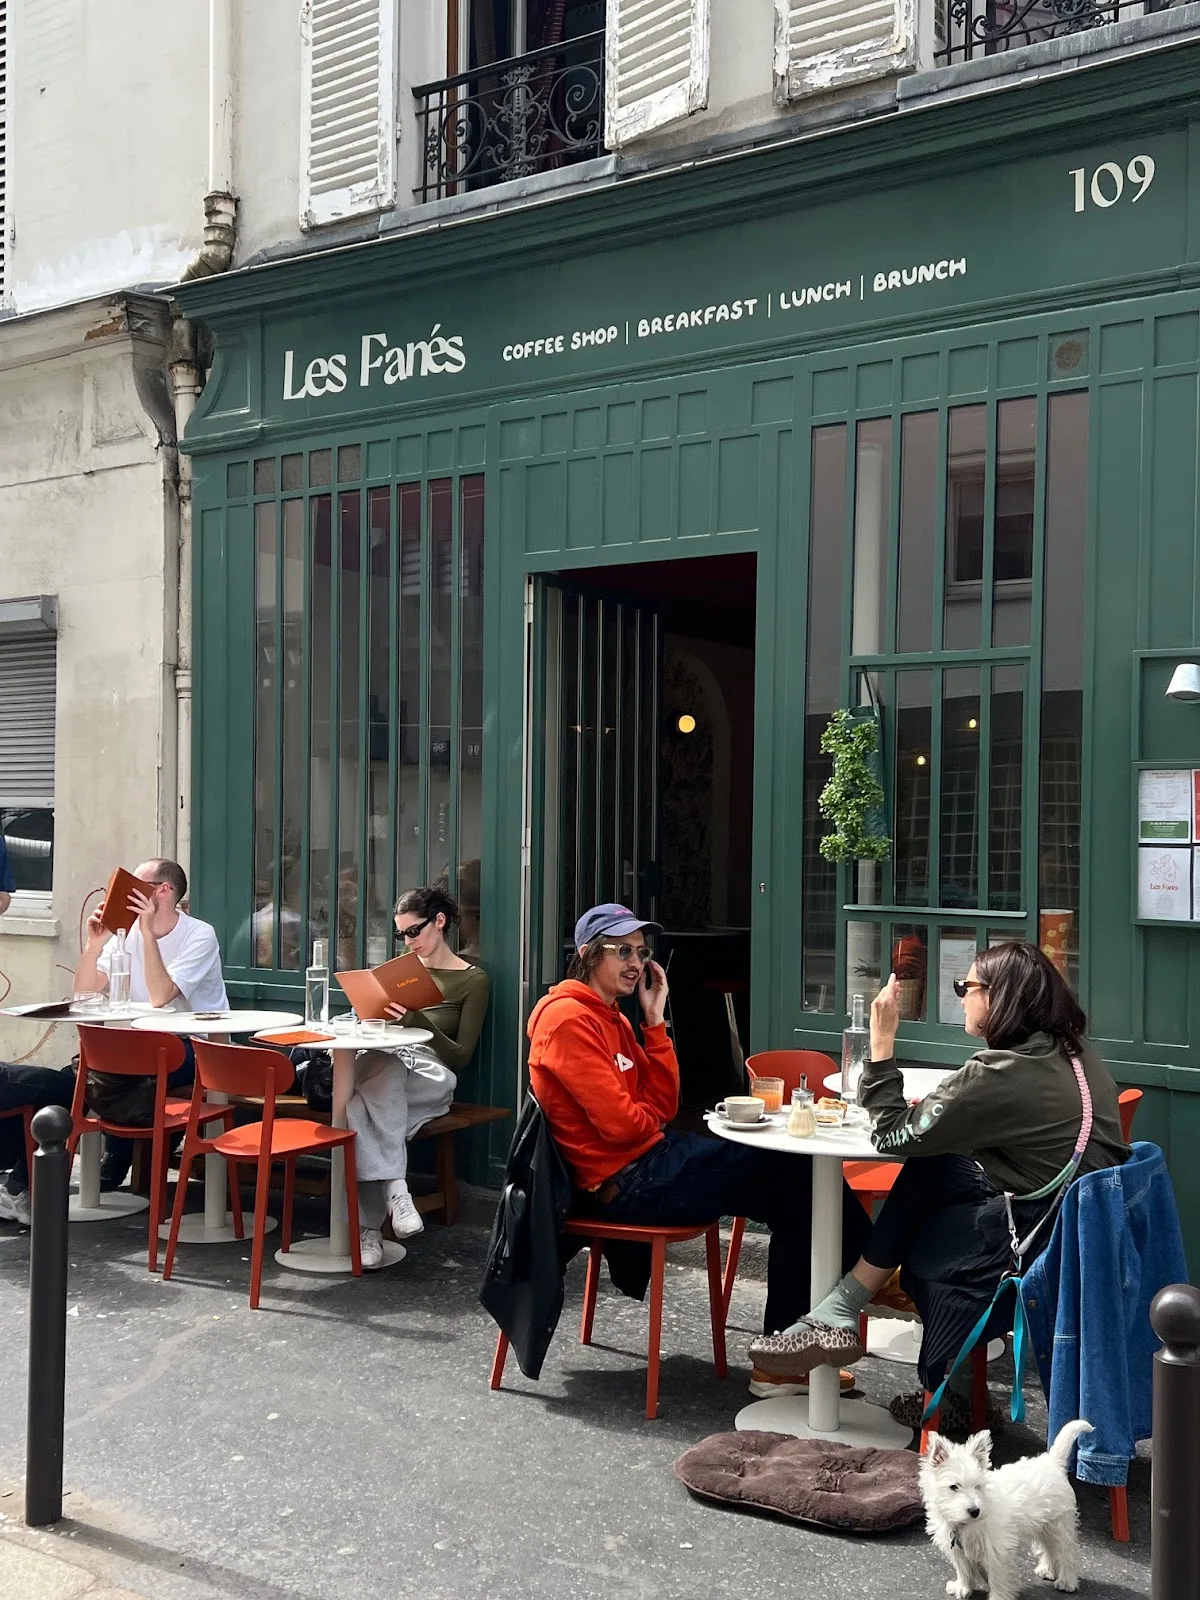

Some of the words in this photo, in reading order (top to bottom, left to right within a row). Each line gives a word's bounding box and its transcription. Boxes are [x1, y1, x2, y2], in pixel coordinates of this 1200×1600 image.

[1068, 154, 1156, 213] 109
[502, 335, 565, 362] COFFEE
[571, 325, 618, 350] SHOP
[637, 298, 758, 337] BREAKFAST
[780, 280, 851, 310] LUNCH
[873, 257, 967, 292] BRUNCH
[283, 350, 347, 400] Les
[360, 323, 466, 387] Fanés
